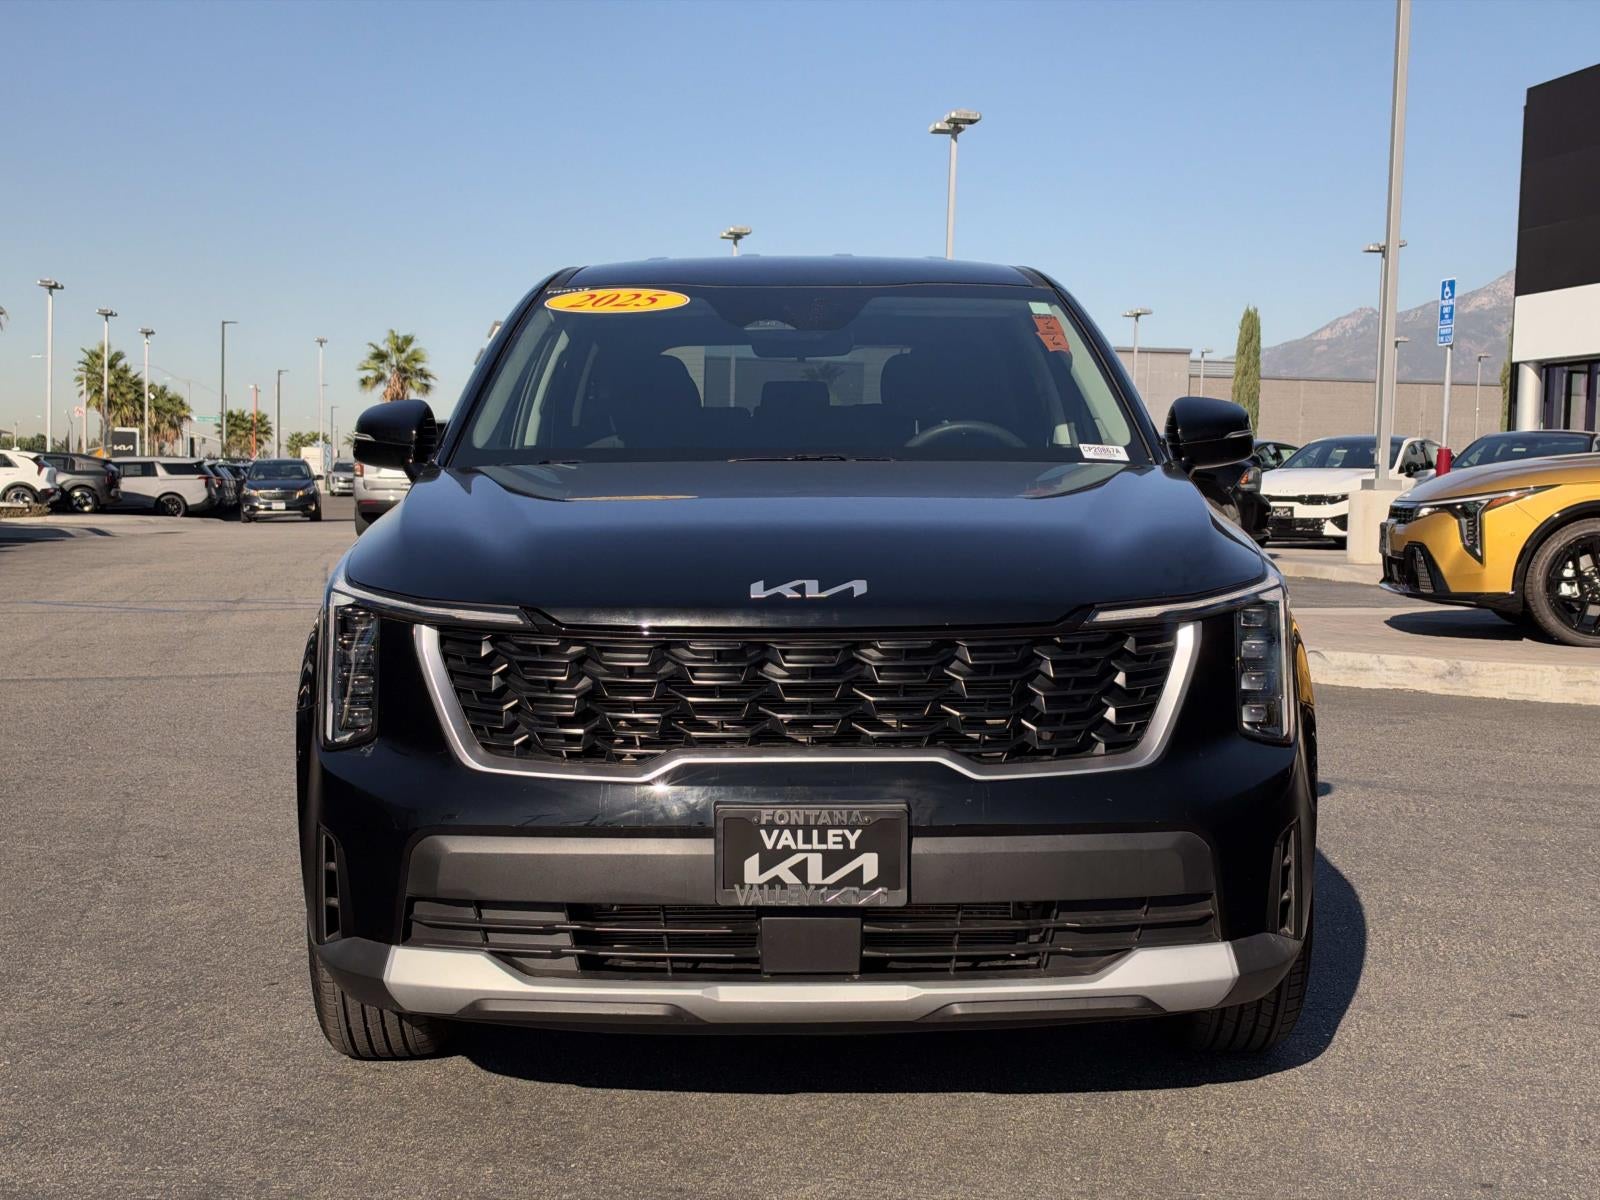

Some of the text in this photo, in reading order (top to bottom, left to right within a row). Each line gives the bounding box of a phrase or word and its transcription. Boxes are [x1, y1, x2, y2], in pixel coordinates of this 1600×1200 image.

[566, 293, 667, 308] 2025
[750, 579, 868, 598] KIA
[759, 809, 866, 826] FONTANA
[759, 829, 863, 850] VALLEY
[743, 852, 879, 885] KIA
[733, 883, 889, 905] VALLEY KIA
